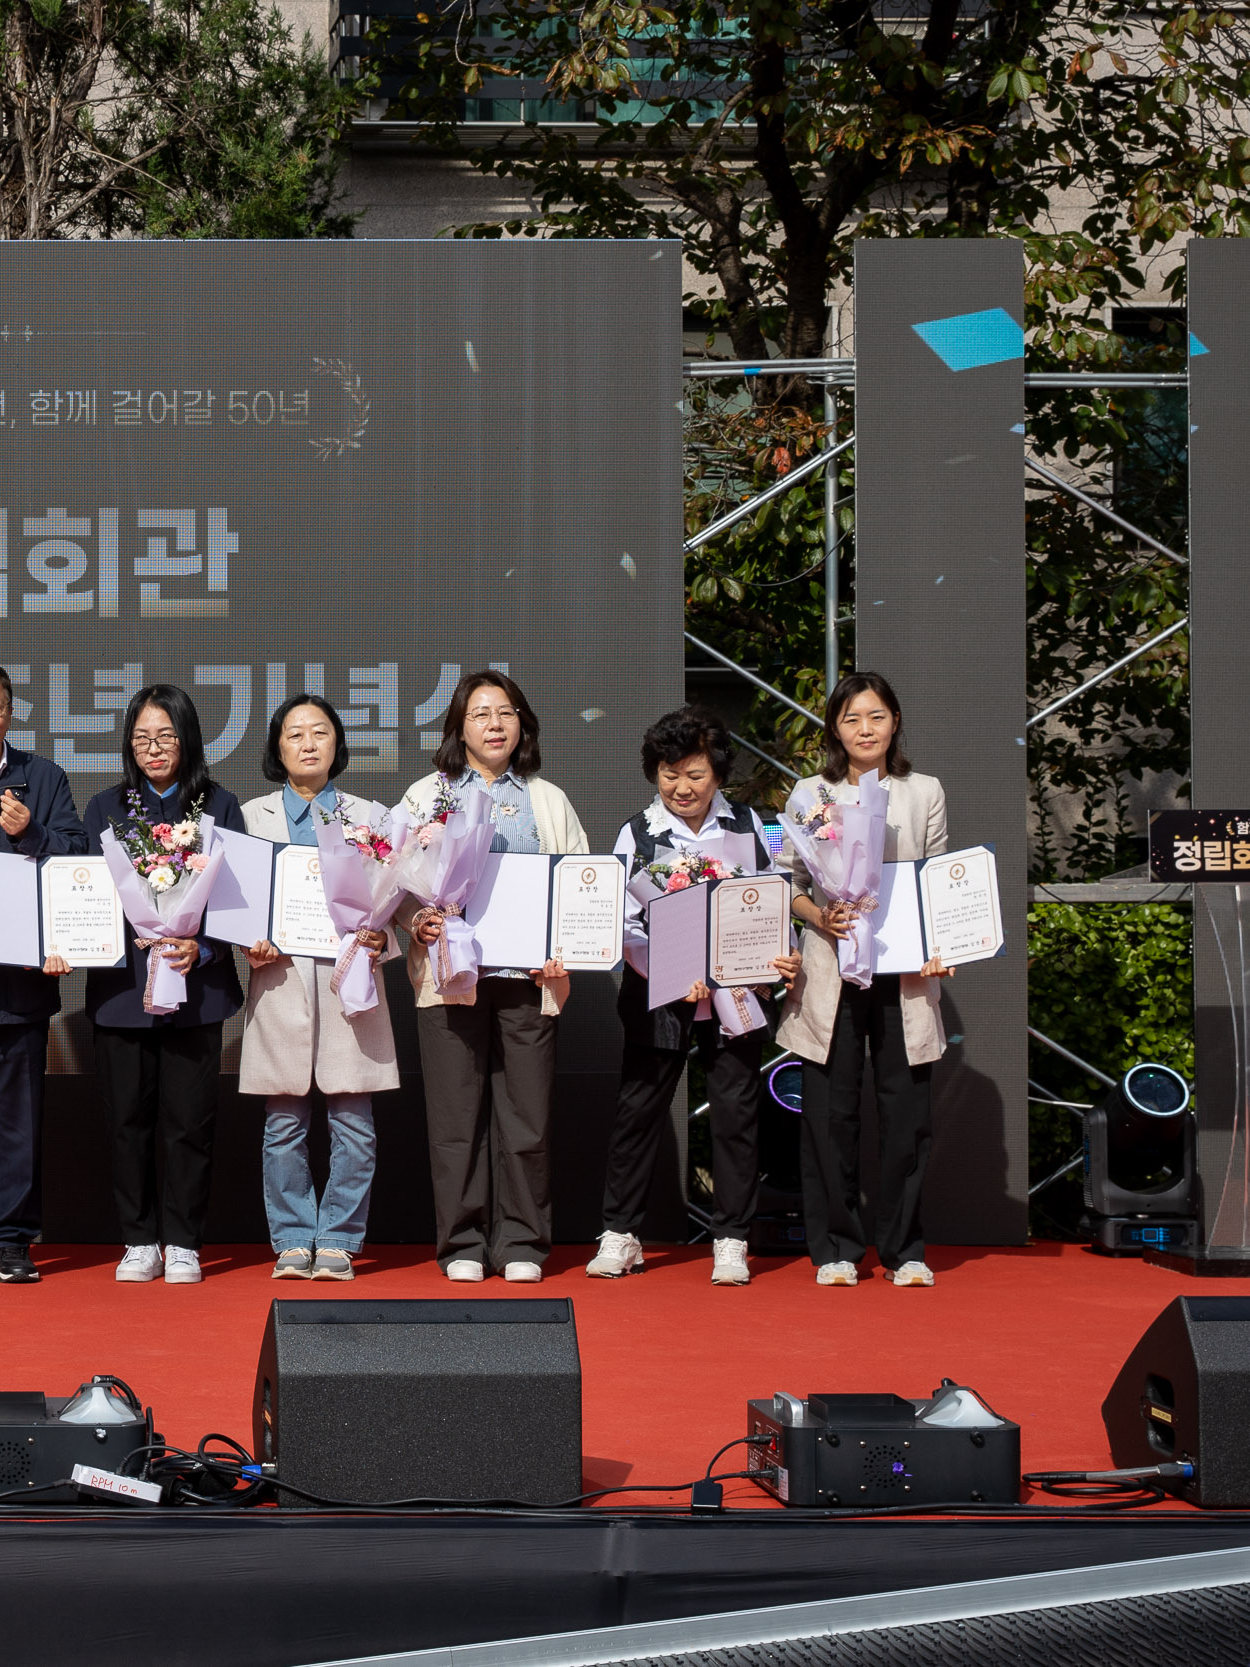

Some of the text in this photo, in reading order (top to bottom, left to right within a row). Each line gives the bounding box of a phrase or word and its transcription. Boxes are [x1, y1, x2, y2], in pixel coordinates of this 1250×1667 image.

[29, 389, 97, 426] 함께
[112, 389, 216, 426] 걸어갈
[228, 389, 309, 425] 50년
[1236, 821, 1250, 835] 함
